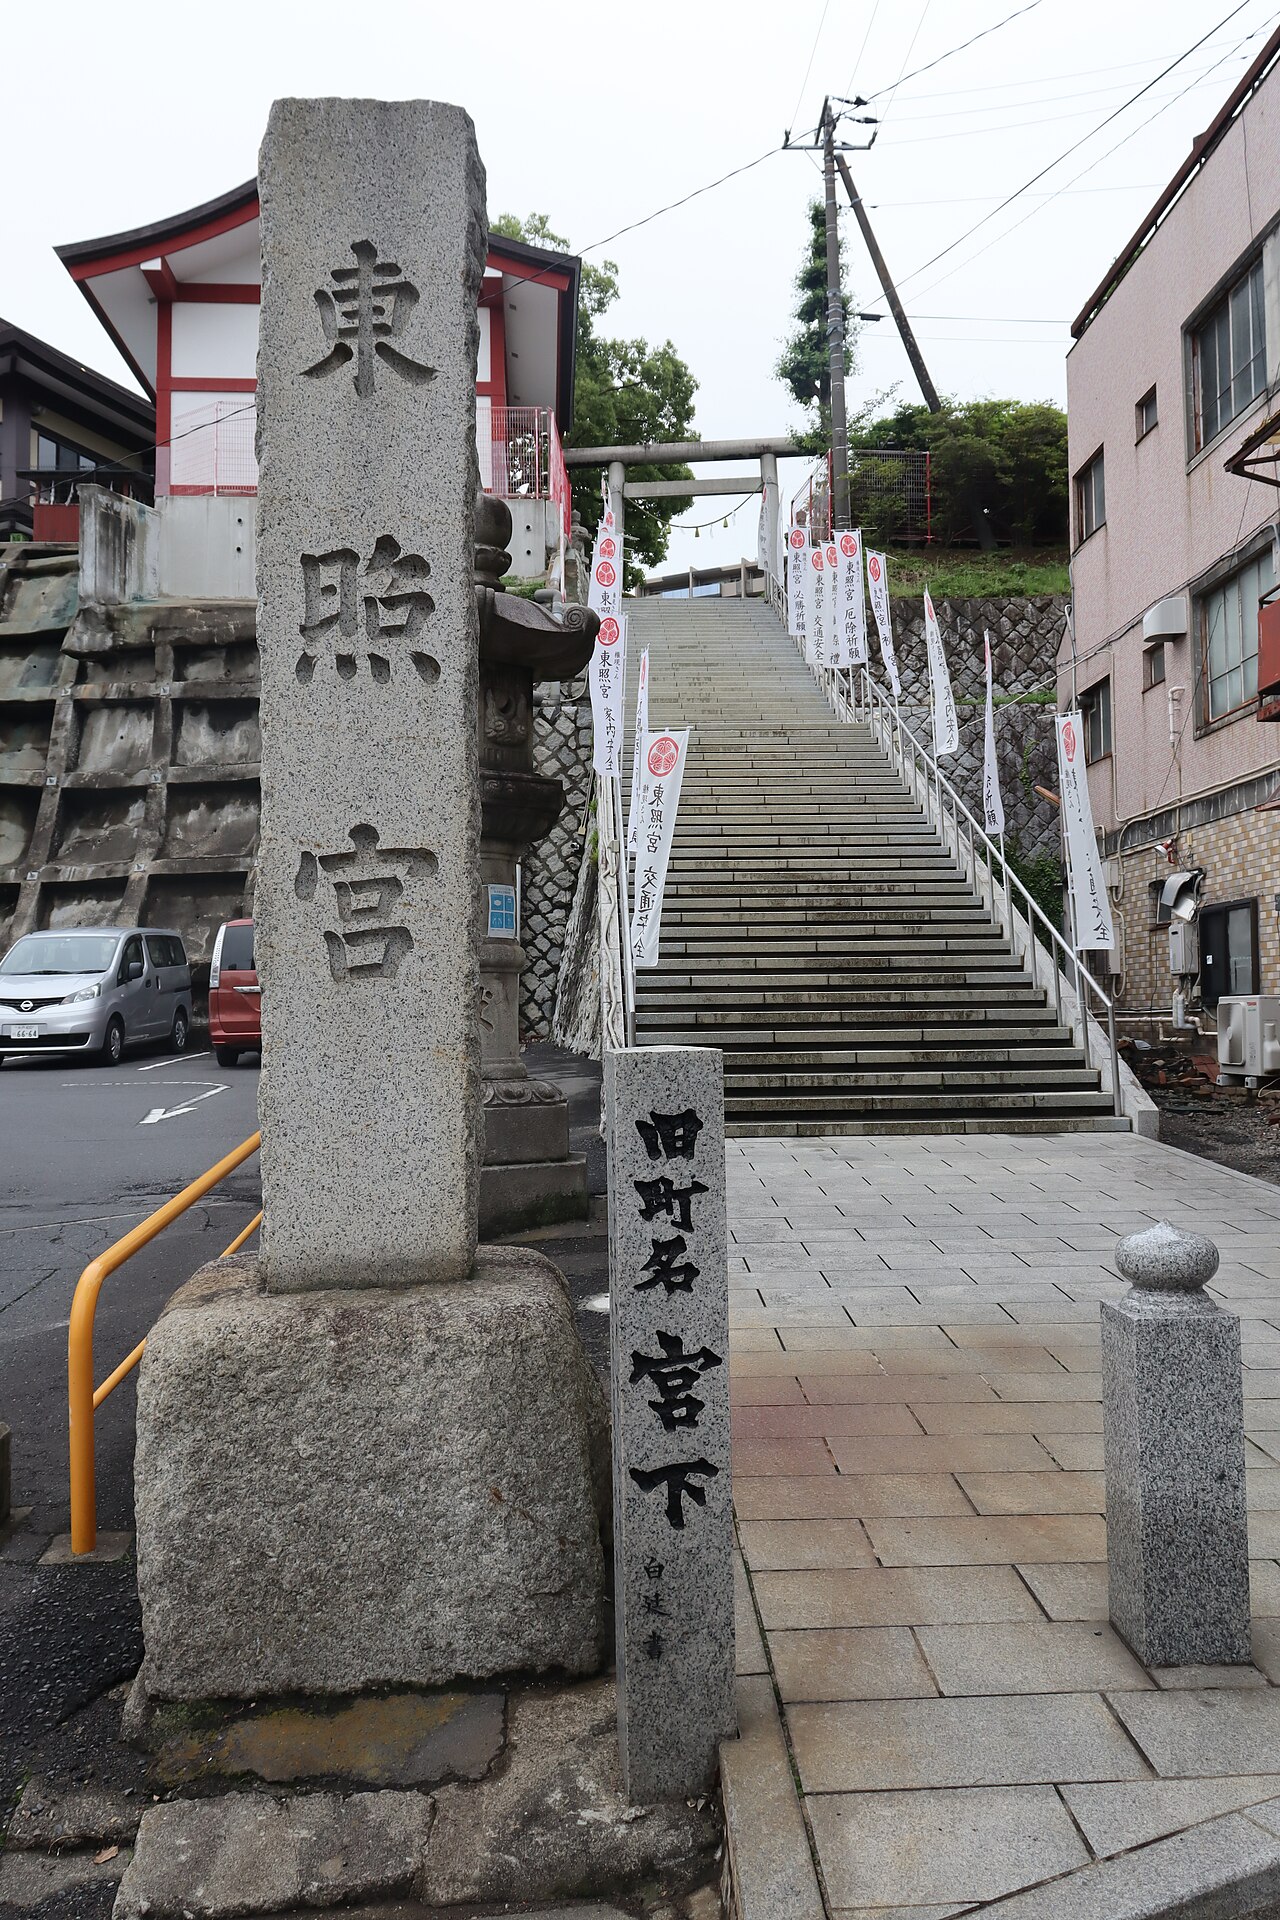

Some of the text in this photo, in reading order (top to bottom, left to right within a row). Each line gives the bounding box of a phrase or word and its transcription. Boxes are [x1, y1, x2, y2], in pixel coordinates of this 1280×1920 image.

[295, 239, 442, 983] 東照宮
[792, 551, 807, 632] 東照宮 必勝祈願
[813, 574, 824, 660] 東照宮 交通安全
[844, 560, 861, 659] 東照宮 厄除祈願
[599, 650, 616, 771] 東照宮 家内安全
[646, 783, 665, 854] 東照宮
[633, 866, 658, 959] 交通安全
